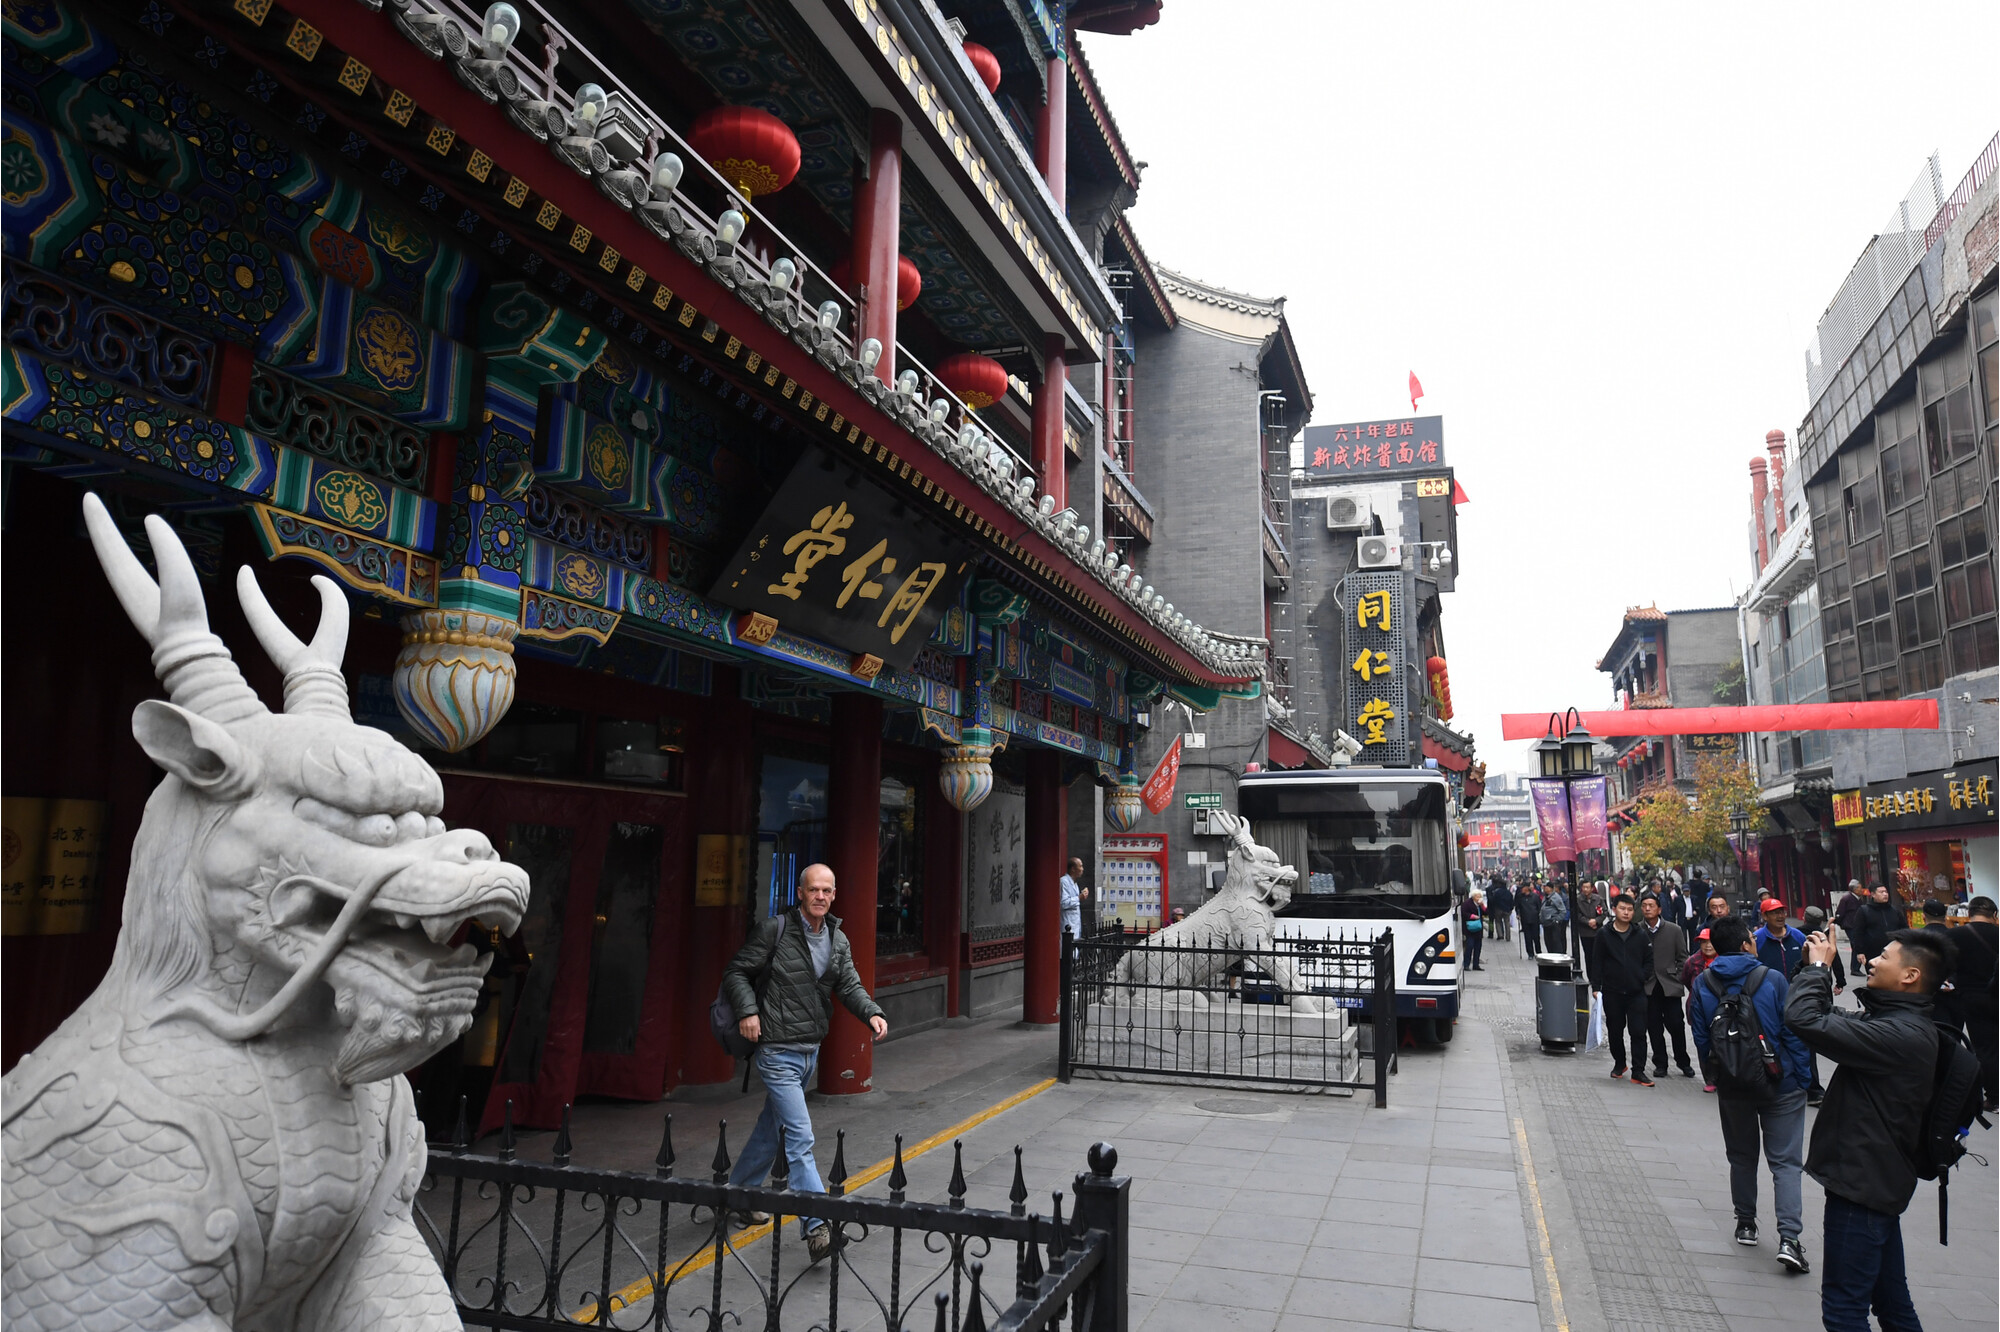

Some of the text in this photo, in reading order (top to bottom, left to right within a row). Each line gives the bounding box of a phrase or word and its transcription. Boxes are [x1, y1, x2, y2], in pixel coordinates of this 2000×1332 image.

[1335, 421, 1414, 442] 六十年老店
[1311, 440, 1438, 470] 新成炸酱面馆
[767, 501, 947, 645] 同仁堂
[1353, 590, 1394, 746] 同仁堂
[1949, 776, 1990, 810] 稻香村
[1103, 839, 1161, 848] 馆专家简介
